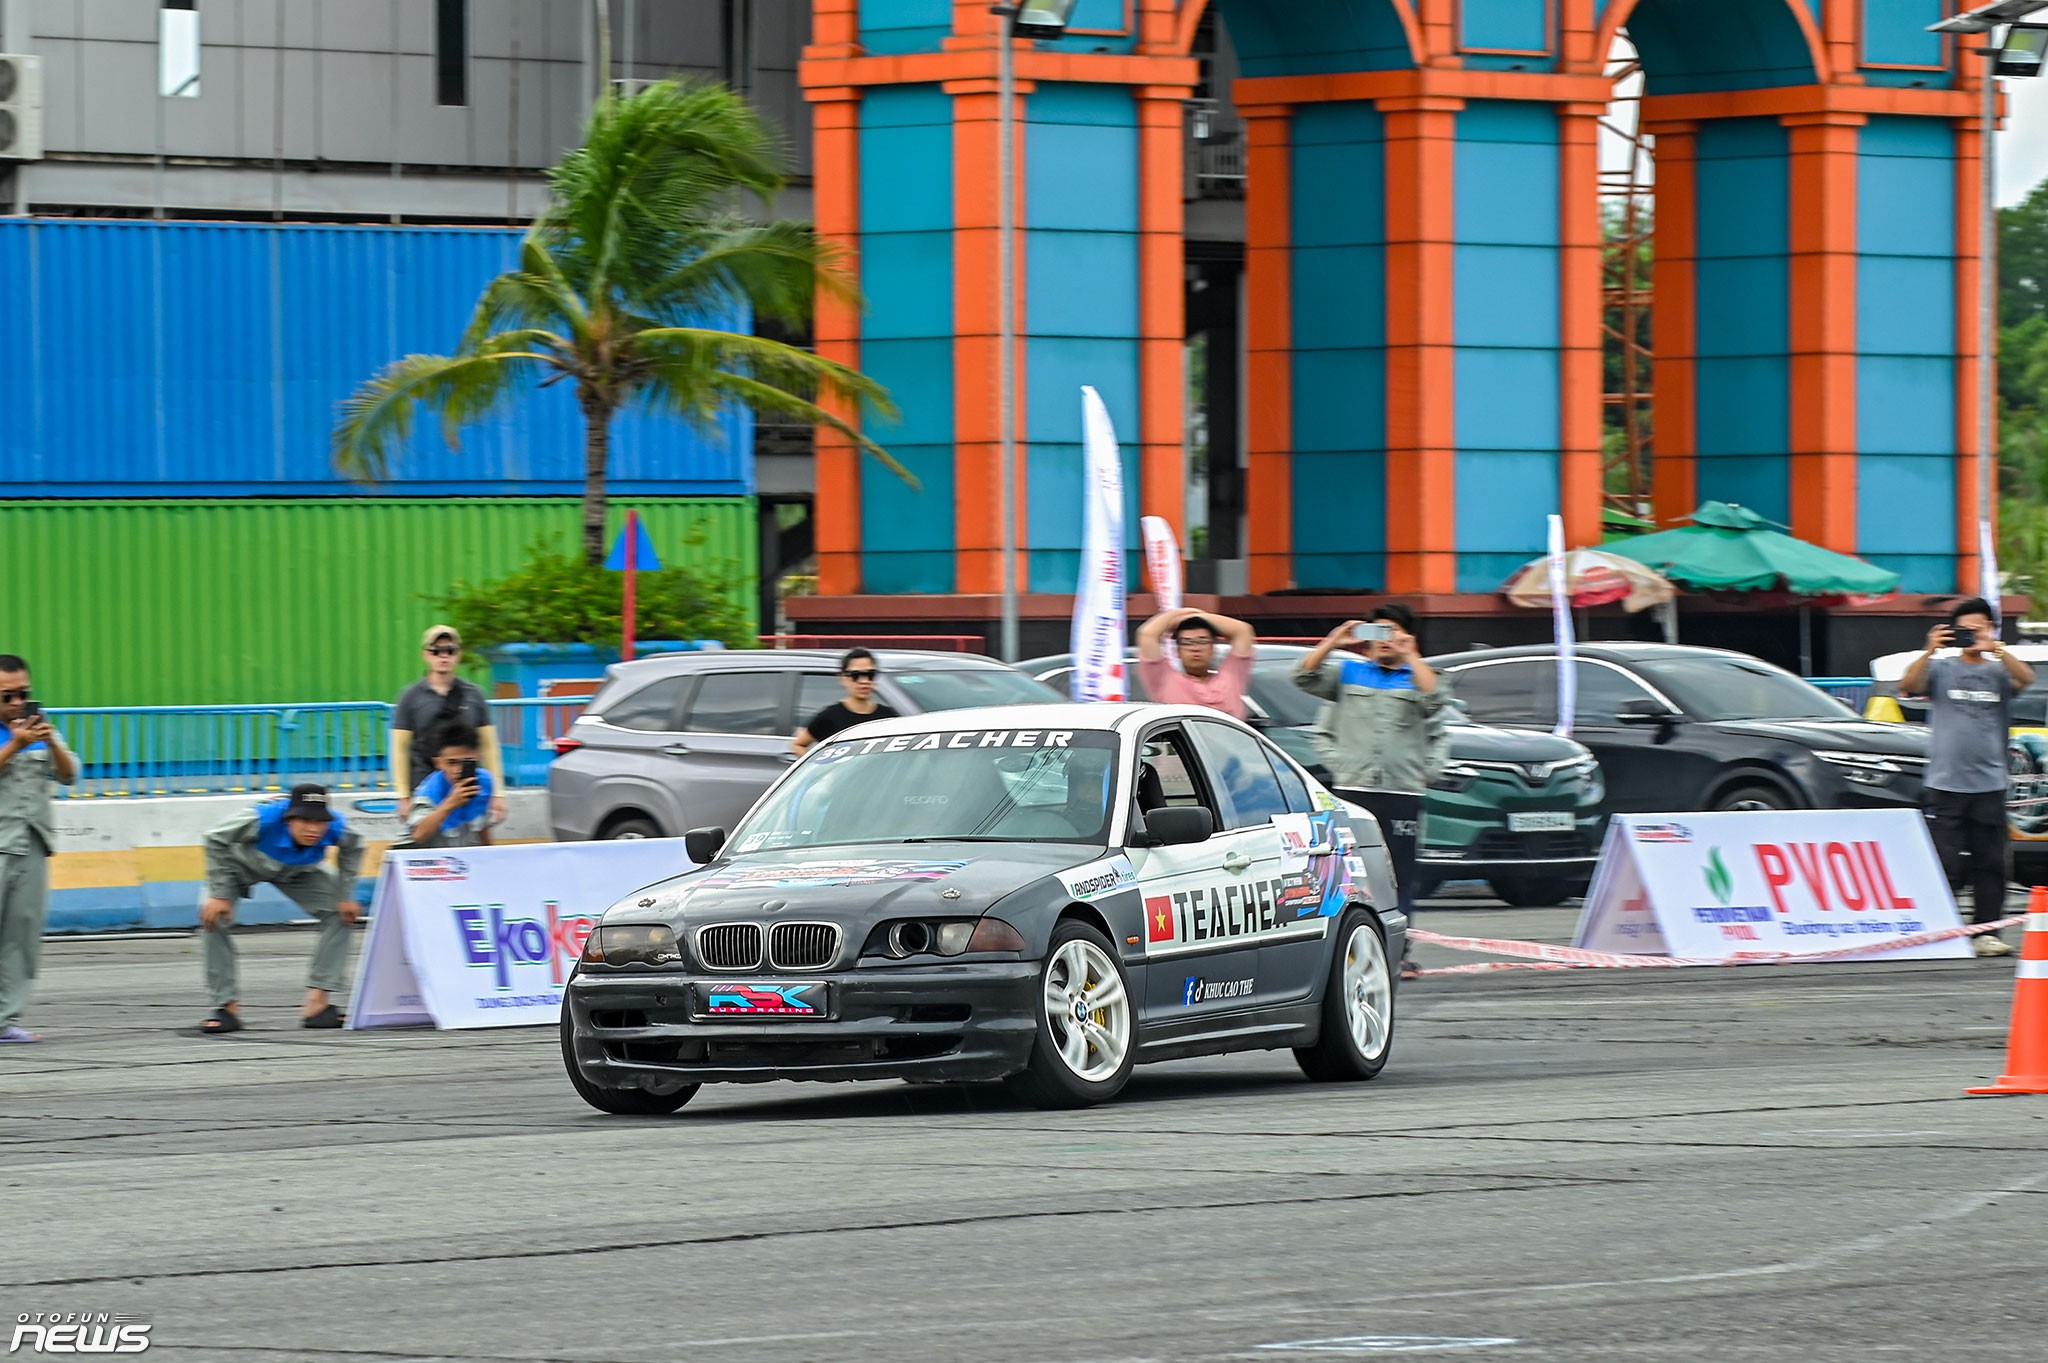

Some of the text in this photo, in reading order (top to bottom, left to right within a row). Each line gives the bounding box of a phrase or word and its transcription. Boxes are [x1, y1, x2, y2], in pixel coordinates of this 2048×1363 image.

[816, 746, 851, 761] 39
[859, 730, 1074, 755] TEACHER
[903, 794, 949, 806] RECARO
[1070, 871, 1136, 899] LANDSPIDER tires
[1753, 840, 1916, 913] PVOIL
[449, 900, 602, 991] Ekoke
[1204, 978, 1255, 999] KHUC CAO THE
